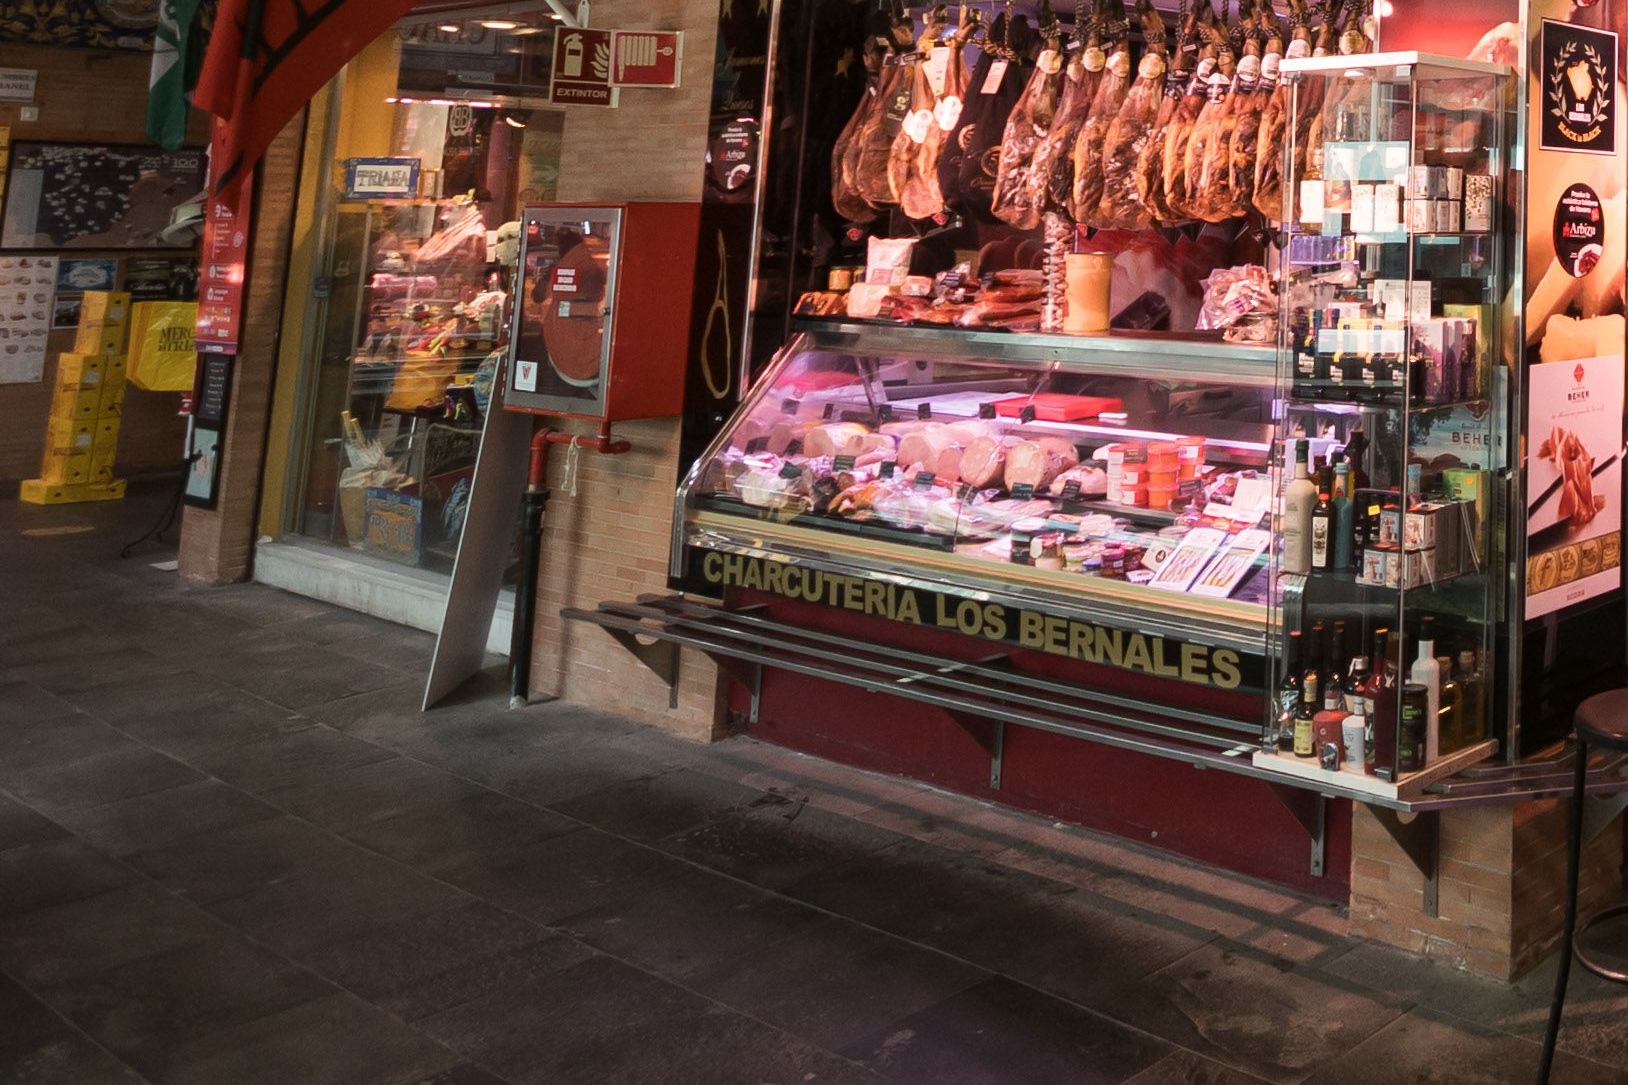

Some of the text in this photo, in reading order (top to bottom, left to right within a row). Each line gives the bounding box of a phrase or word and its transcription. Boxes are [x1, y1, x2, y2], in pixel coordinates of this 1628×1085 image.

[557, 88, 608, 99] EXTINTOR
[357, 168, 409, 188] TRIANA
[1570, 222, 1596, 237] Arbizu
[1568, 390, 1590, 402] BEHER
[936, 600, 1008, 641] LOS
[1019, 609, 1242, 690] BERNALES
